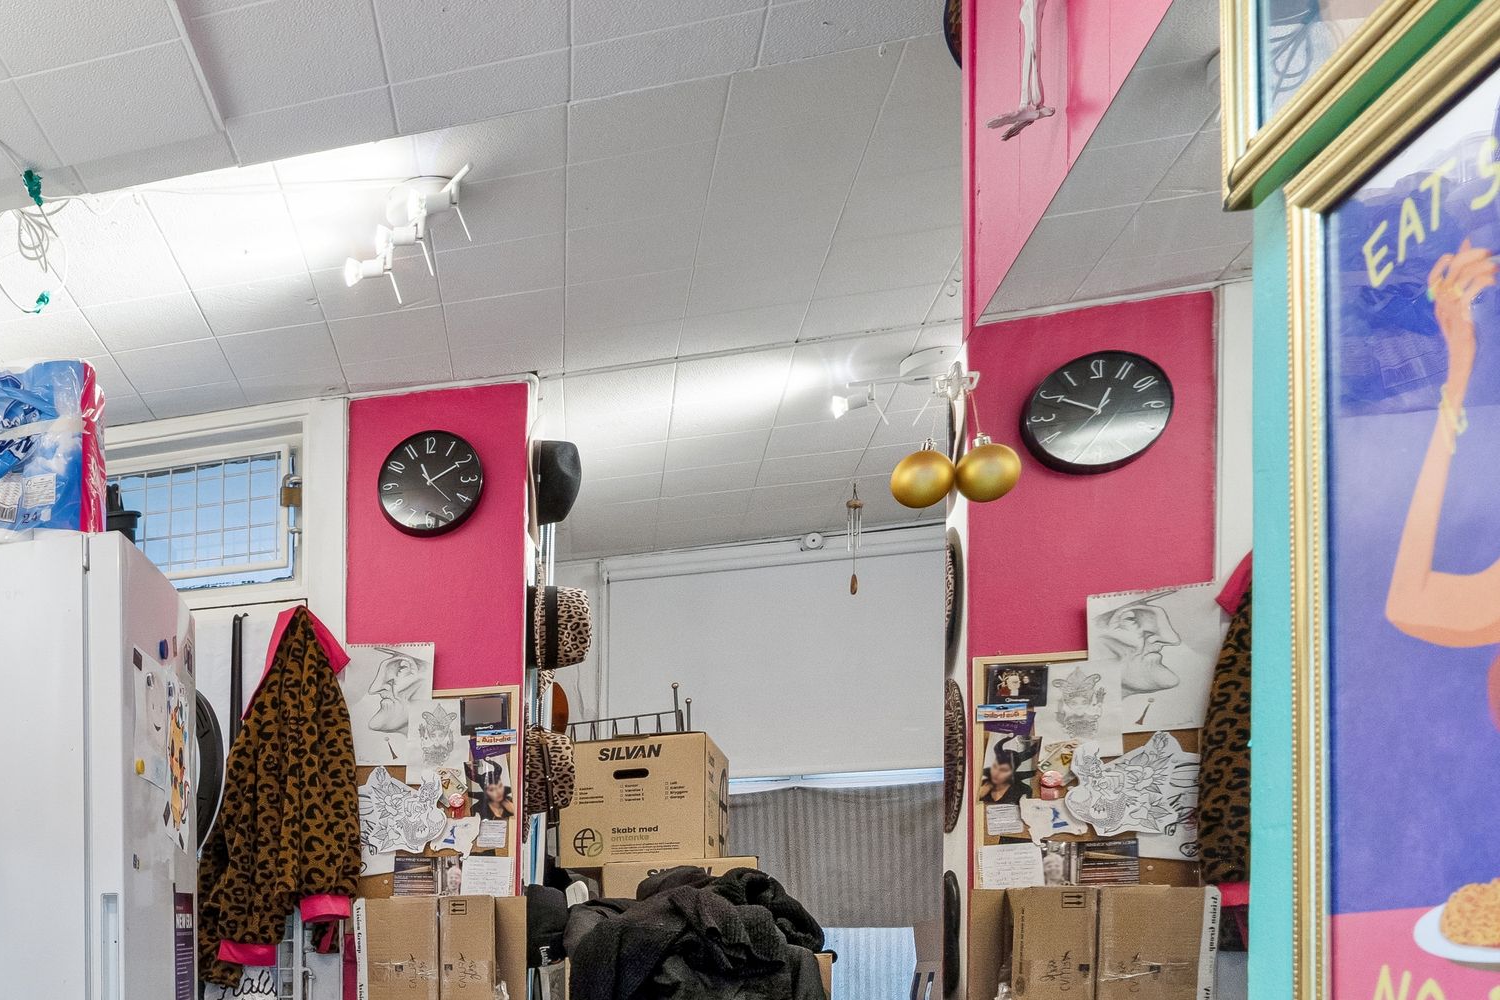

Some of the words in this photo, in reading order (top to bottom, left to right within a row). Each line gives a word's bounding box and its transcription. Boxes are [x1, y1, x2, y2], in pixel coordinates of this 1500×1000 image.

[1363, 158, 1458, 288] EAT
[404, 444, 418, 460] 11
[425, 436, 436, 454] 12
[445, 441, 456, 457] 1
[387, 460, 405, 474] 10
[454, 453, 473, 468] 2
[460, 474, 479, 483] 3
[382, 482, 399, 491] 9
[456, 492, 472, 503] 4
[425, 511, 435, 529] 6
[442, 505, 455, 521] 5
[598, 744, 662, 761] SILVAN
[612, 826, 636, 834] Skabt
[611, 834, 650, 842] omtanke
